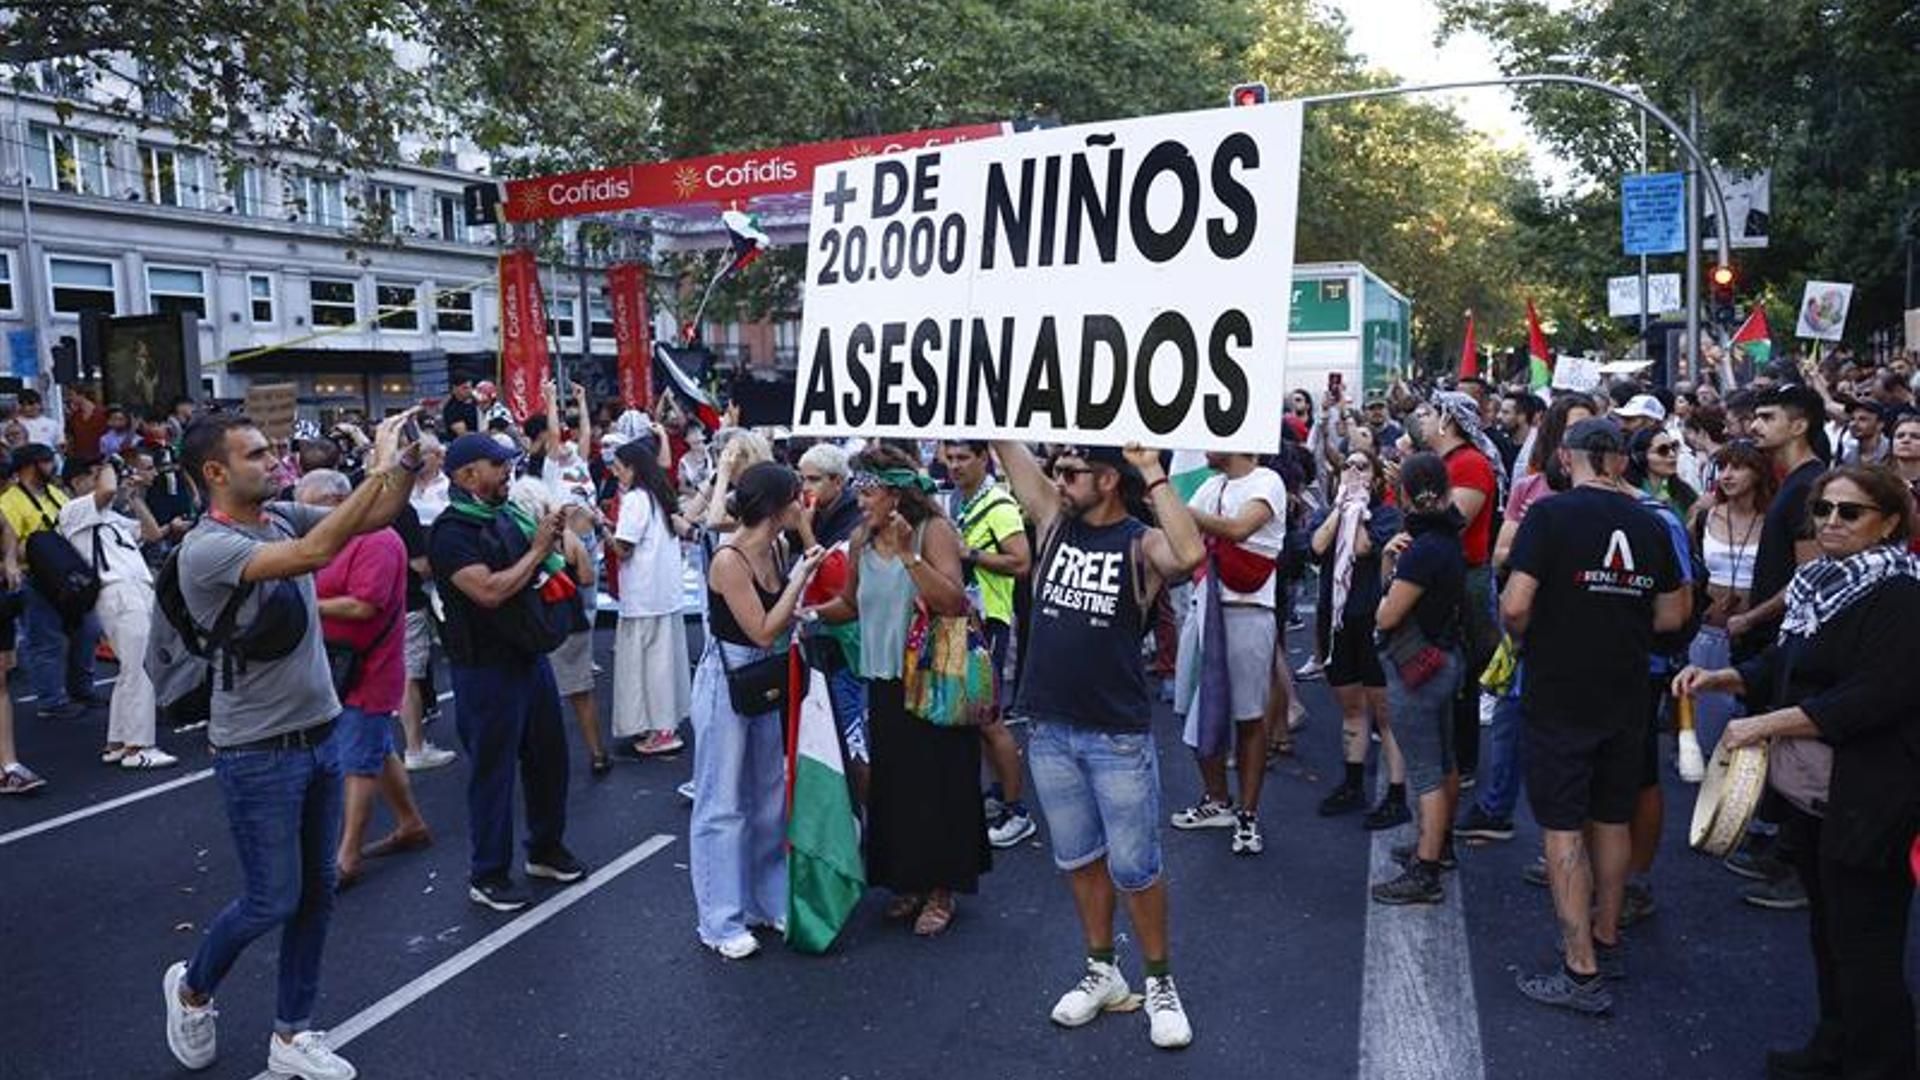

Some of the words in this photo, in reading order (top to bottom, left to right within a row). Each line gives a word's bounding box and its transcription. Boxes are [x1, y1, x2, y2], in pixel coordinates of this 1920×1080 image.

[549, 178, 630, 205] Cofidis
[705, 158, 797, 188] Cofidis
[872, 152, 941, 219] DE
[980, 132, 1260, 270] NIÑOS
[817, 213, 966, 286] 20.000
[506, 284, 520, 339] Cofidis
[799, 310, 1253, 438] ASESINADOS
[1047, 542, 1123, 594] FREE
[1042, 582, 1118, 616] PALESTINE
